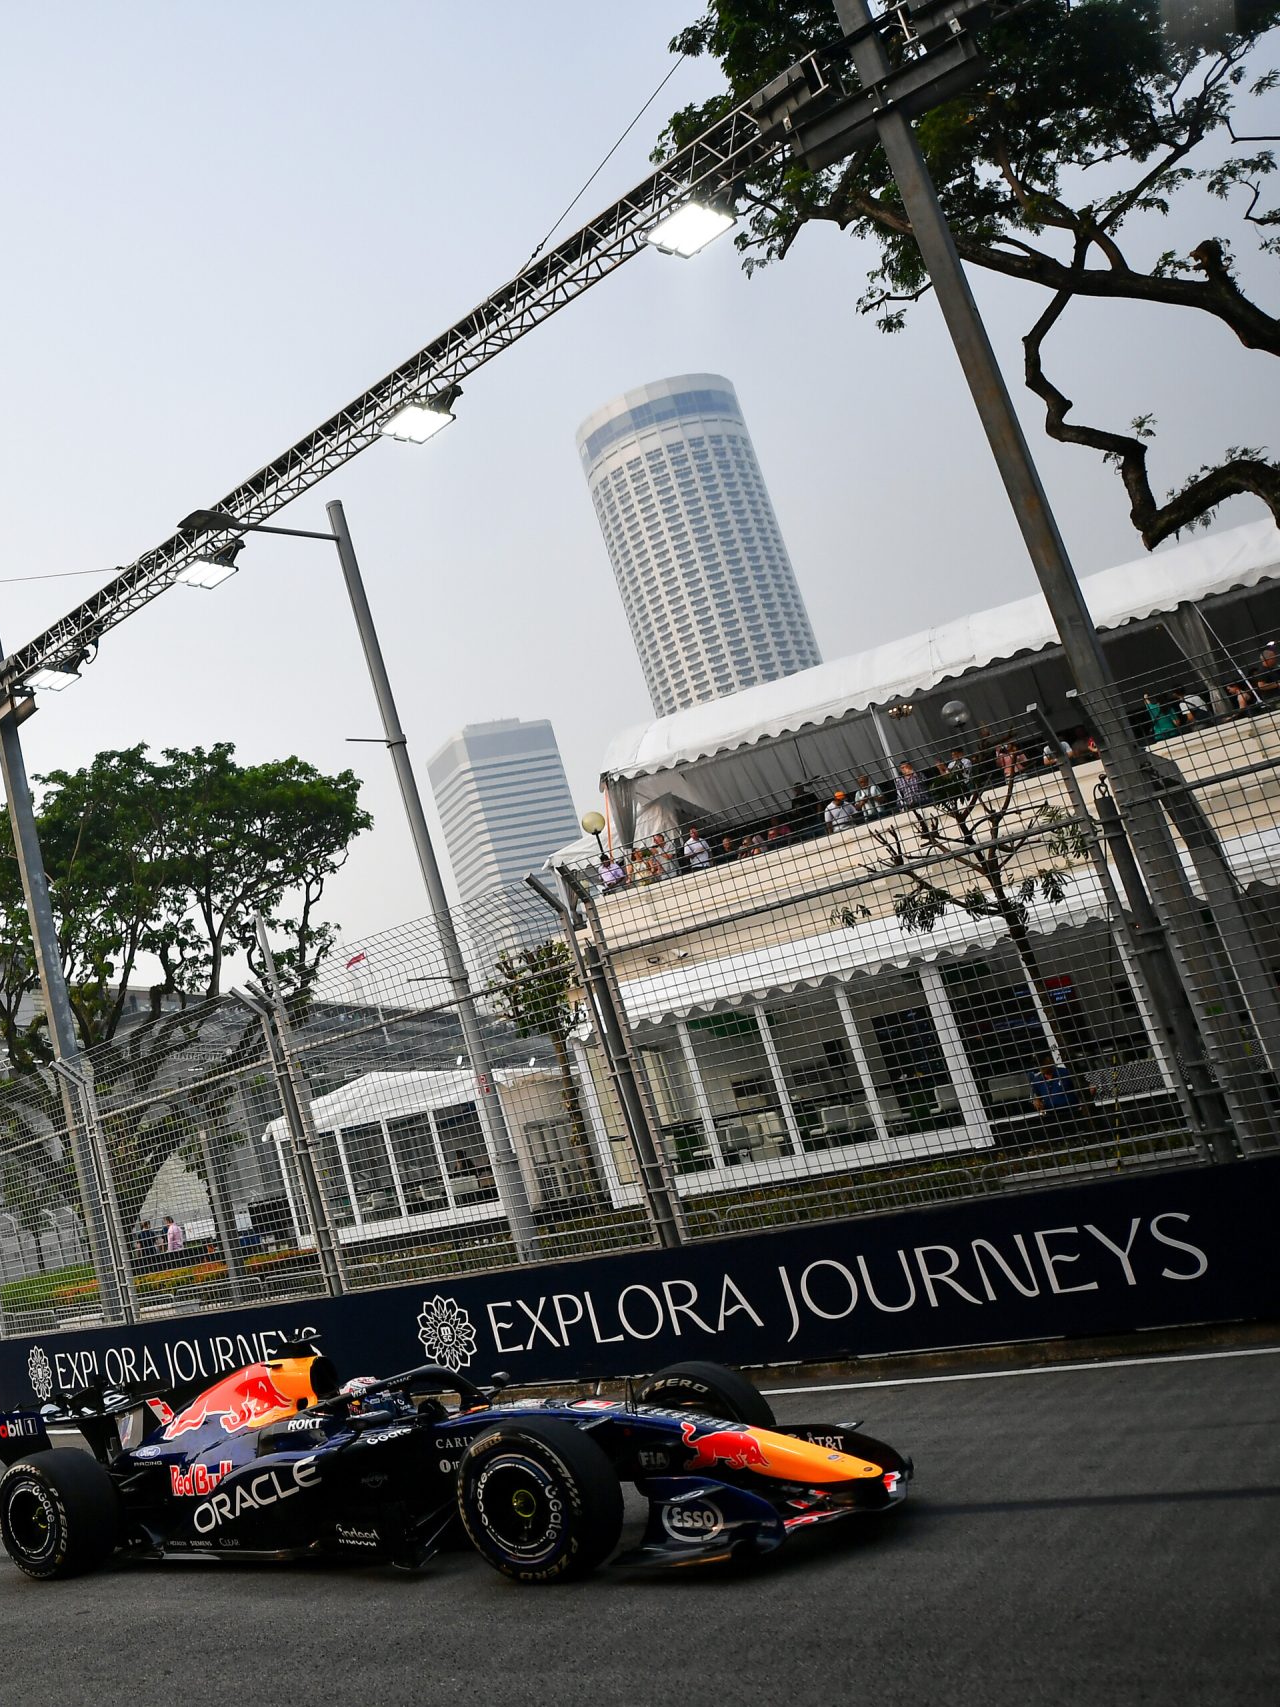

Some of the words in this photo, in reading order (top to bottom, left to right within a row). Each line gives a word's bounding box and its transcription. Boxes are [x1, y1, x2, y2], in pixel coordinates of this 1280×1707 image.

[486, 1273, 765, 1353] EXPLORA
[778, 1212, 1208, 1343] JOURNEYS
[287, 1418, 324, 1431] ROKT
[169, 1463, 195, 1497] Red
[193, 1455, 322, 1534] ORACLE
[56, 1500, 68, 1553] ZERO
